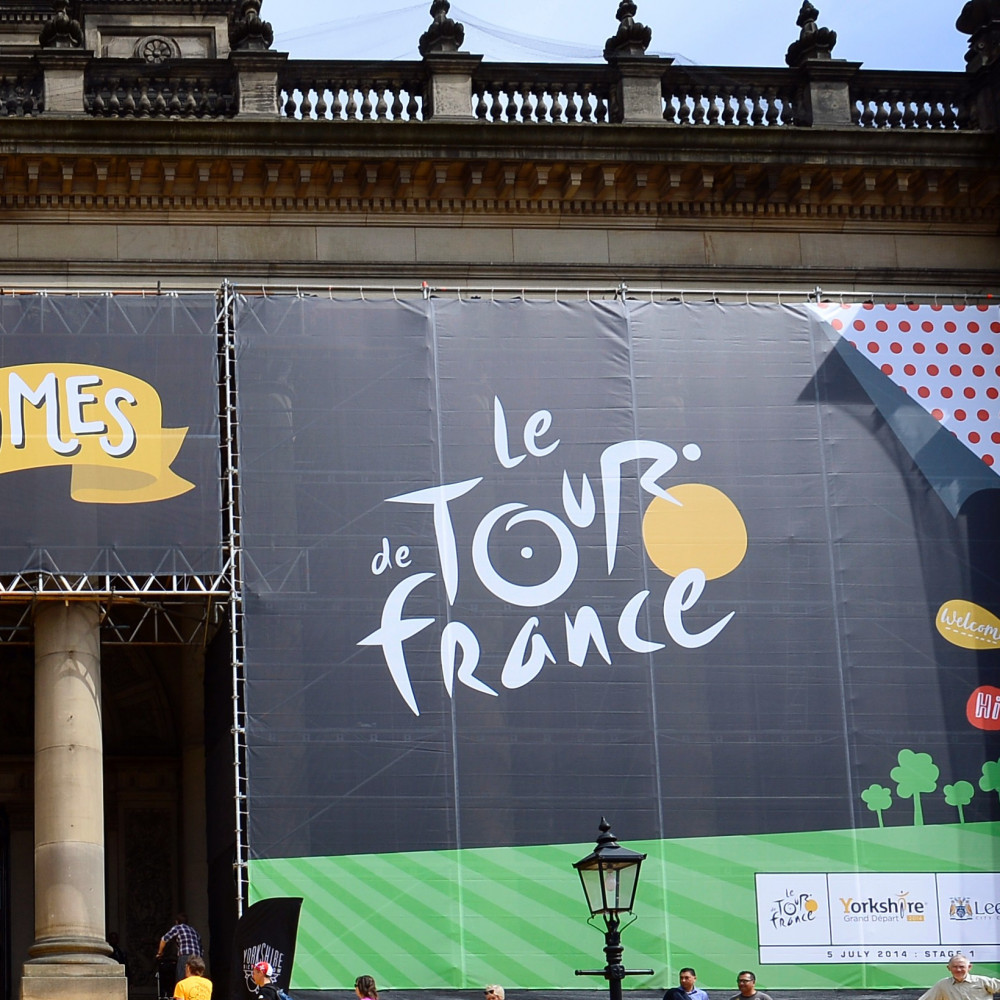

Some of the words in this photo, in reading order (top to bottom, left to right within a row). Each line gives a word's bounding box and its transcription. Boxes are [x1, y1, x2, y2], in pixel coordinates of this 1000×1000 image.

[371, 537, 412, 575] de
[839, 892, 924, 917] Yorkshire
[843, 914, 869, 922] Grand
[841, 950, 870, 958] JULY
